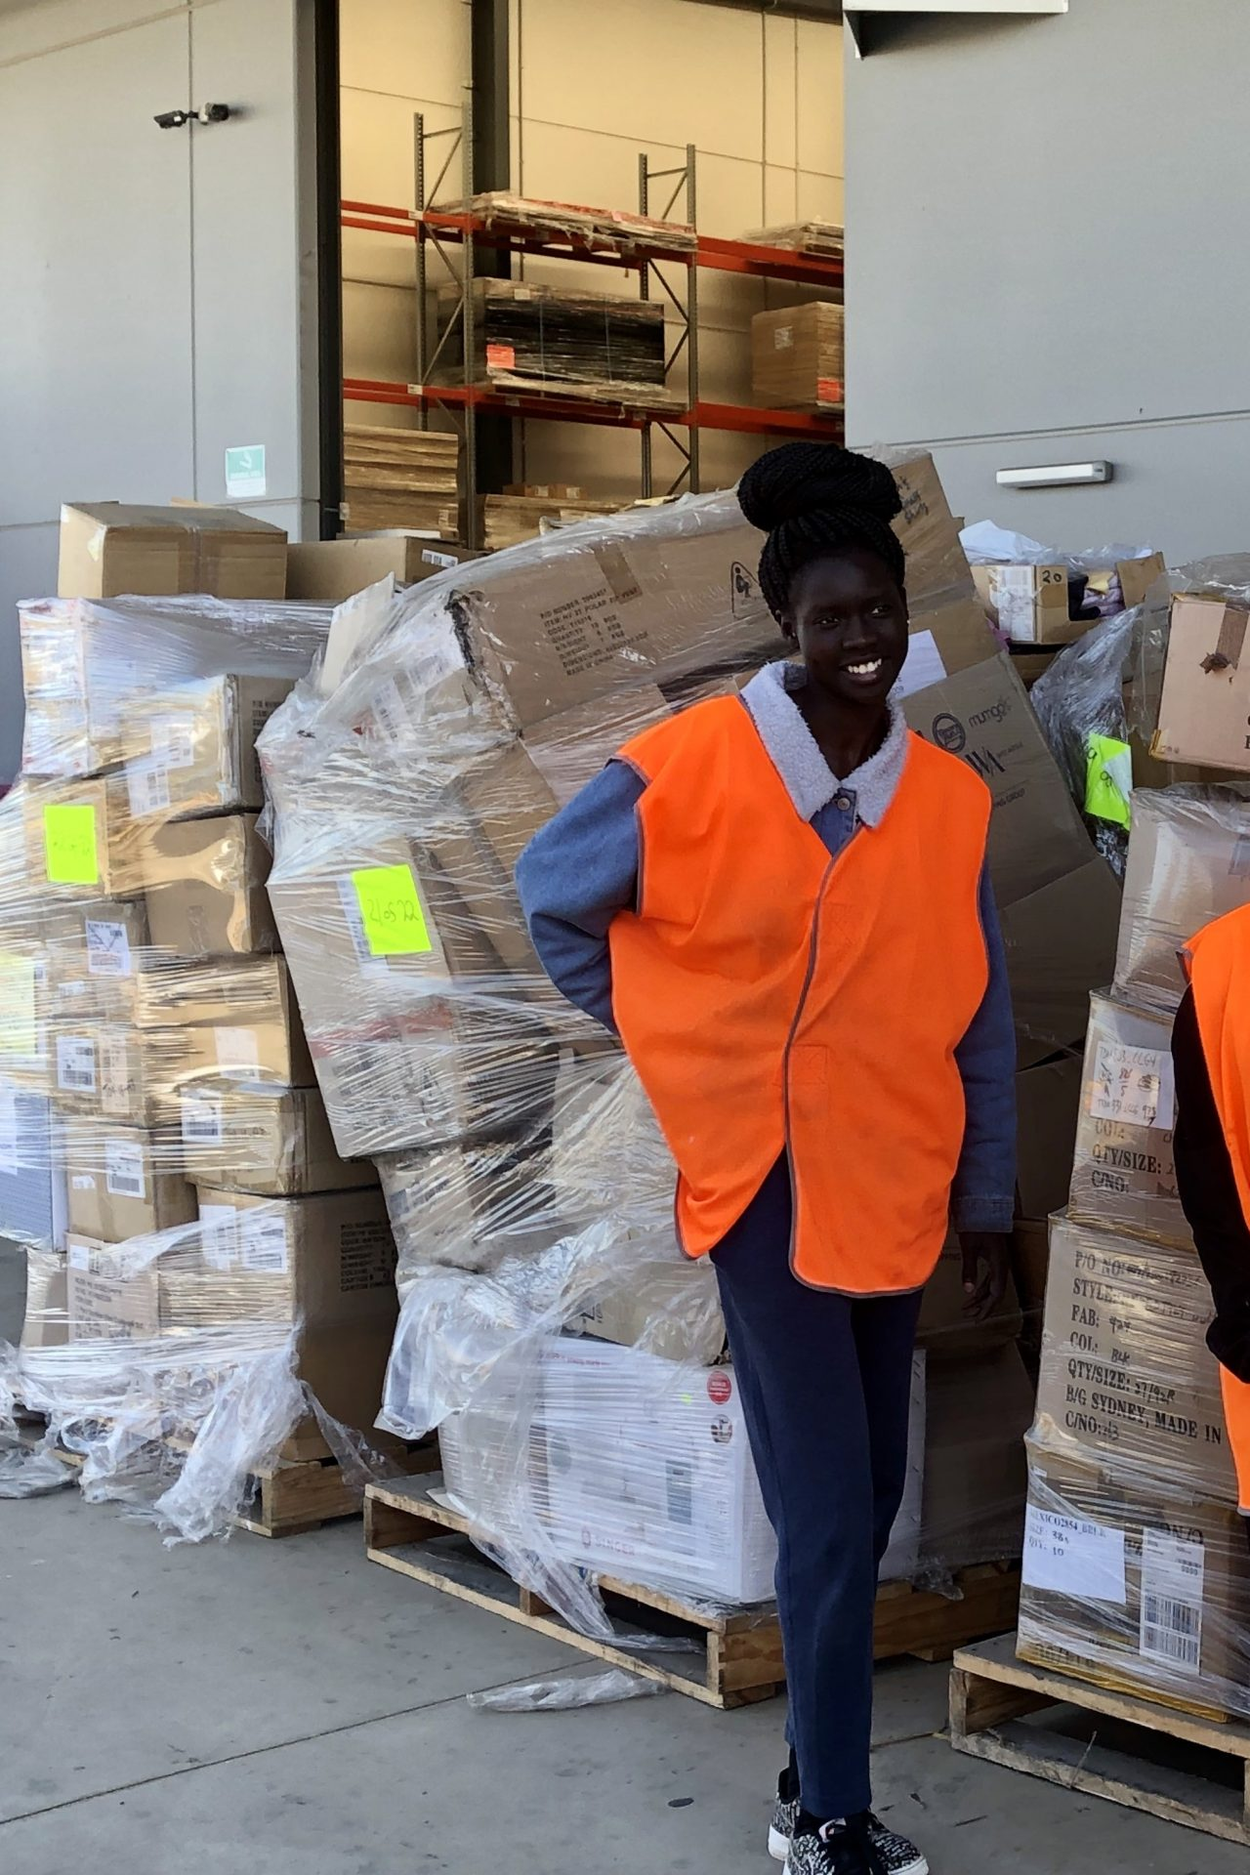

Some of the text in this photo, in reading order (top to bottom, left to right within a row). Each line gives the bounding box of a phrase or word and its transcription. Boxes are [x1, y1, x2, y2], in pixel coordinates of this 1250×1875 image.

[1041, 570, 1062, 583] 20
[1074, 1251, 1096, 1270] P/O
[1071, 1304, 1100, 1328] FAB:
[1069, 1331, 1099, 1354] COL:
[1067, 1357, 1131, 1392] QTY/SIZE:
[1065, 1383, 1087, 1406] B/G
[1154, 1410, 1198, 1439] MADE
[1204, 1423, 1222, 1445] IN
